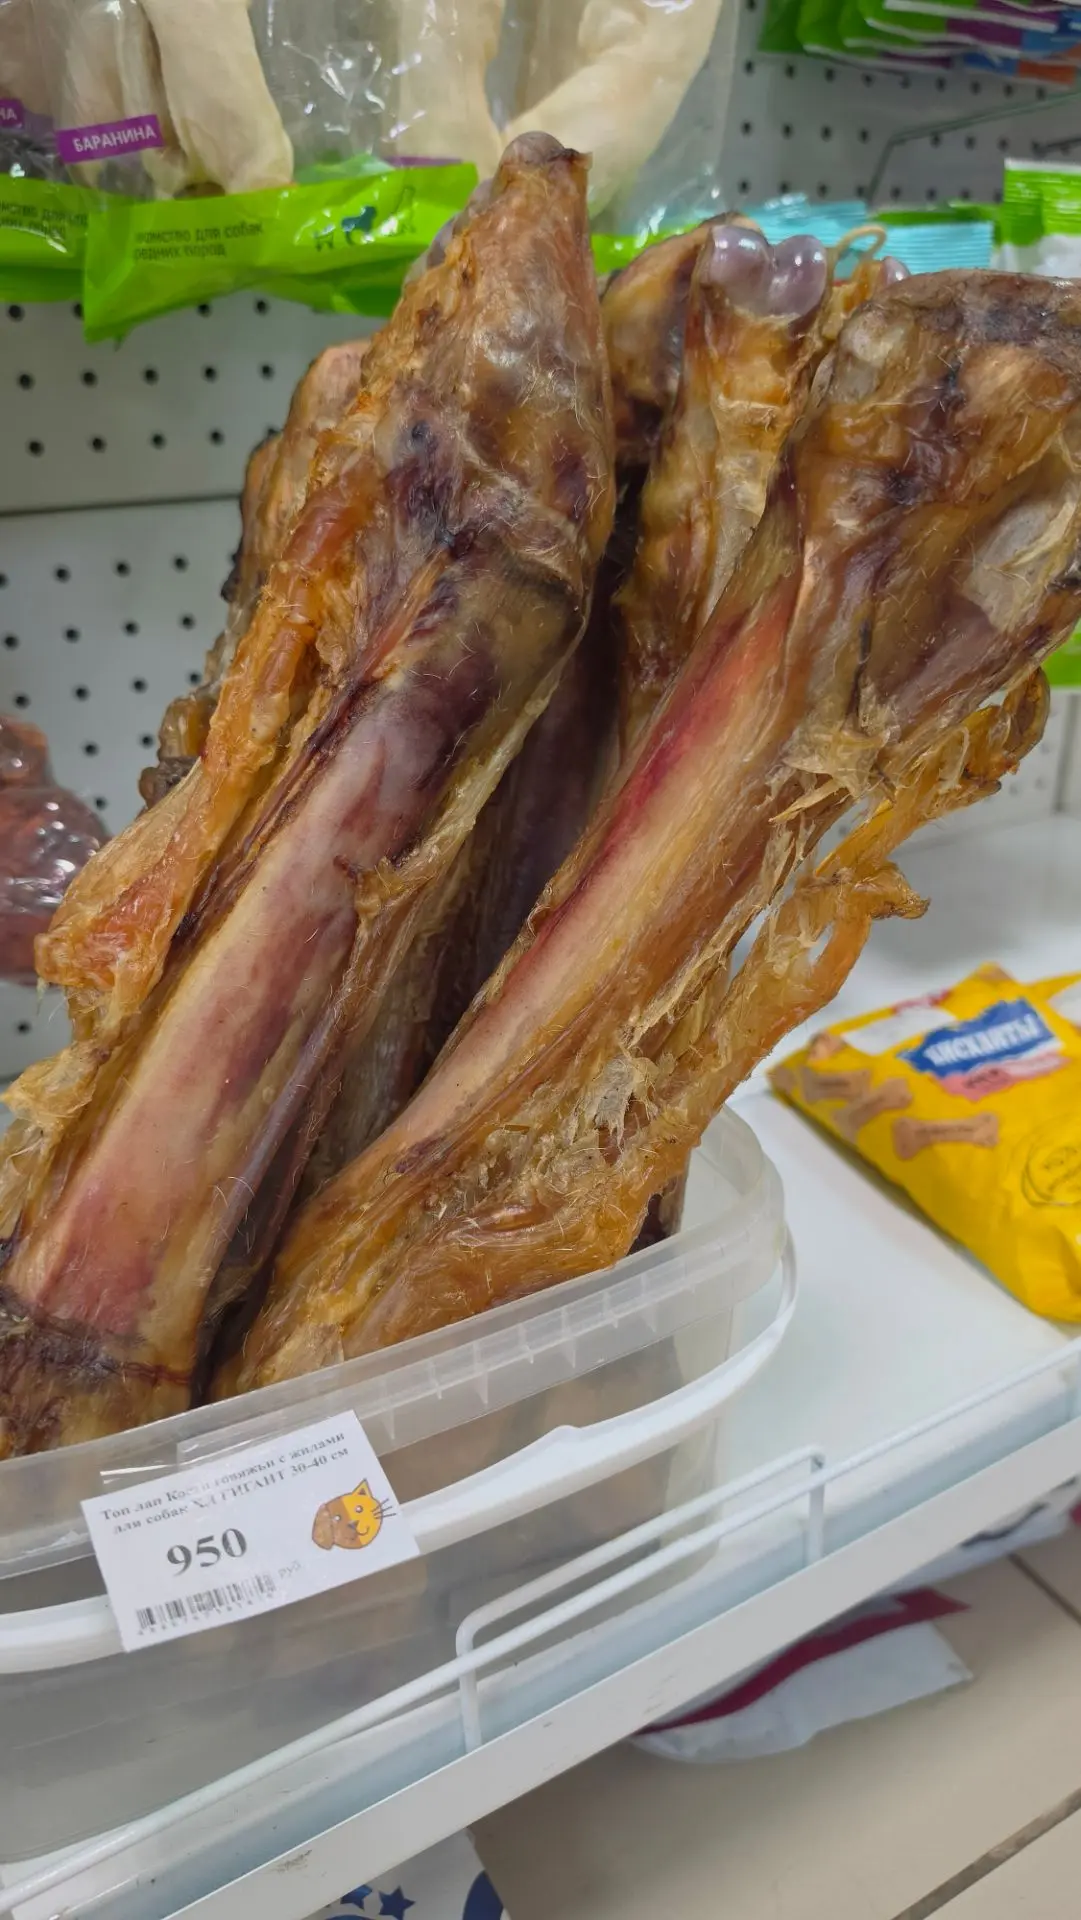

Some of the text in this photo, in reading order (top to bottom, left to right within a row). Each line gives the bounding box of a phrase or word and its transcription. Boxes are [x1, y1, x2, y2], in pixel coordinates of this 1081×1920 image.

[72, 124, 157, 152] БАРАНИНА
[195, 227, 220, 243] для
[223, 220, 263, 239] собак
[101, 1507, 131, 1521] Топ
[134, 1497, 162, 1512] лап
[214, 1459, 275, 1486] говяжьи
[279, 1455, 286, 1464] с
[289, 1432, 345, 1460] жилами
[113, 1520, 142, 1535] для
[145, 1505, 189, 1525] собак
[222, 1469, 285, 1501] ГИГАНТ
[290, 1455, 328, 1477] 30-40
[331, 1447, 349, 1461] см
[166, 1527, 248, 1577] 950
